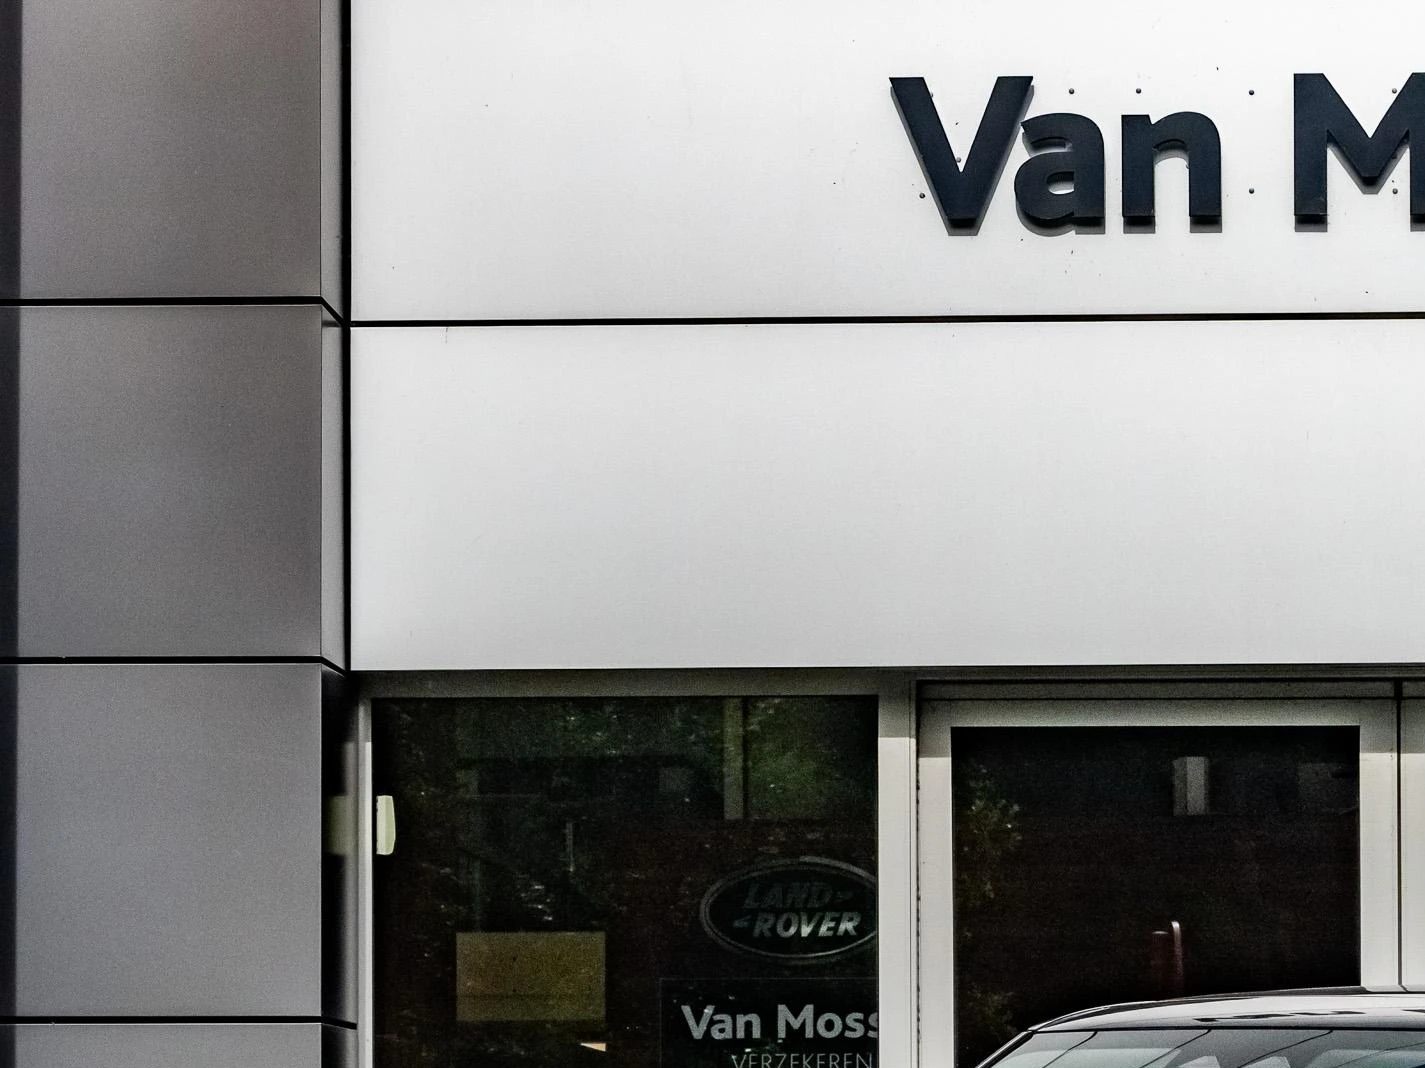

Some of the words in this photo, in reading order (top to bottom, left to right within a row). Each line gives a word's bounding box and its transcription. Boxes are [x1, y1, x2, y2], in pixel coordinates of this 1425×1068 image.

[889, 76, 1223, 226] Van
[743, 882, 833, 909] LAND
[752, 911, 862, 938] ROVER
[681, 1005, 761, 1040] Van
